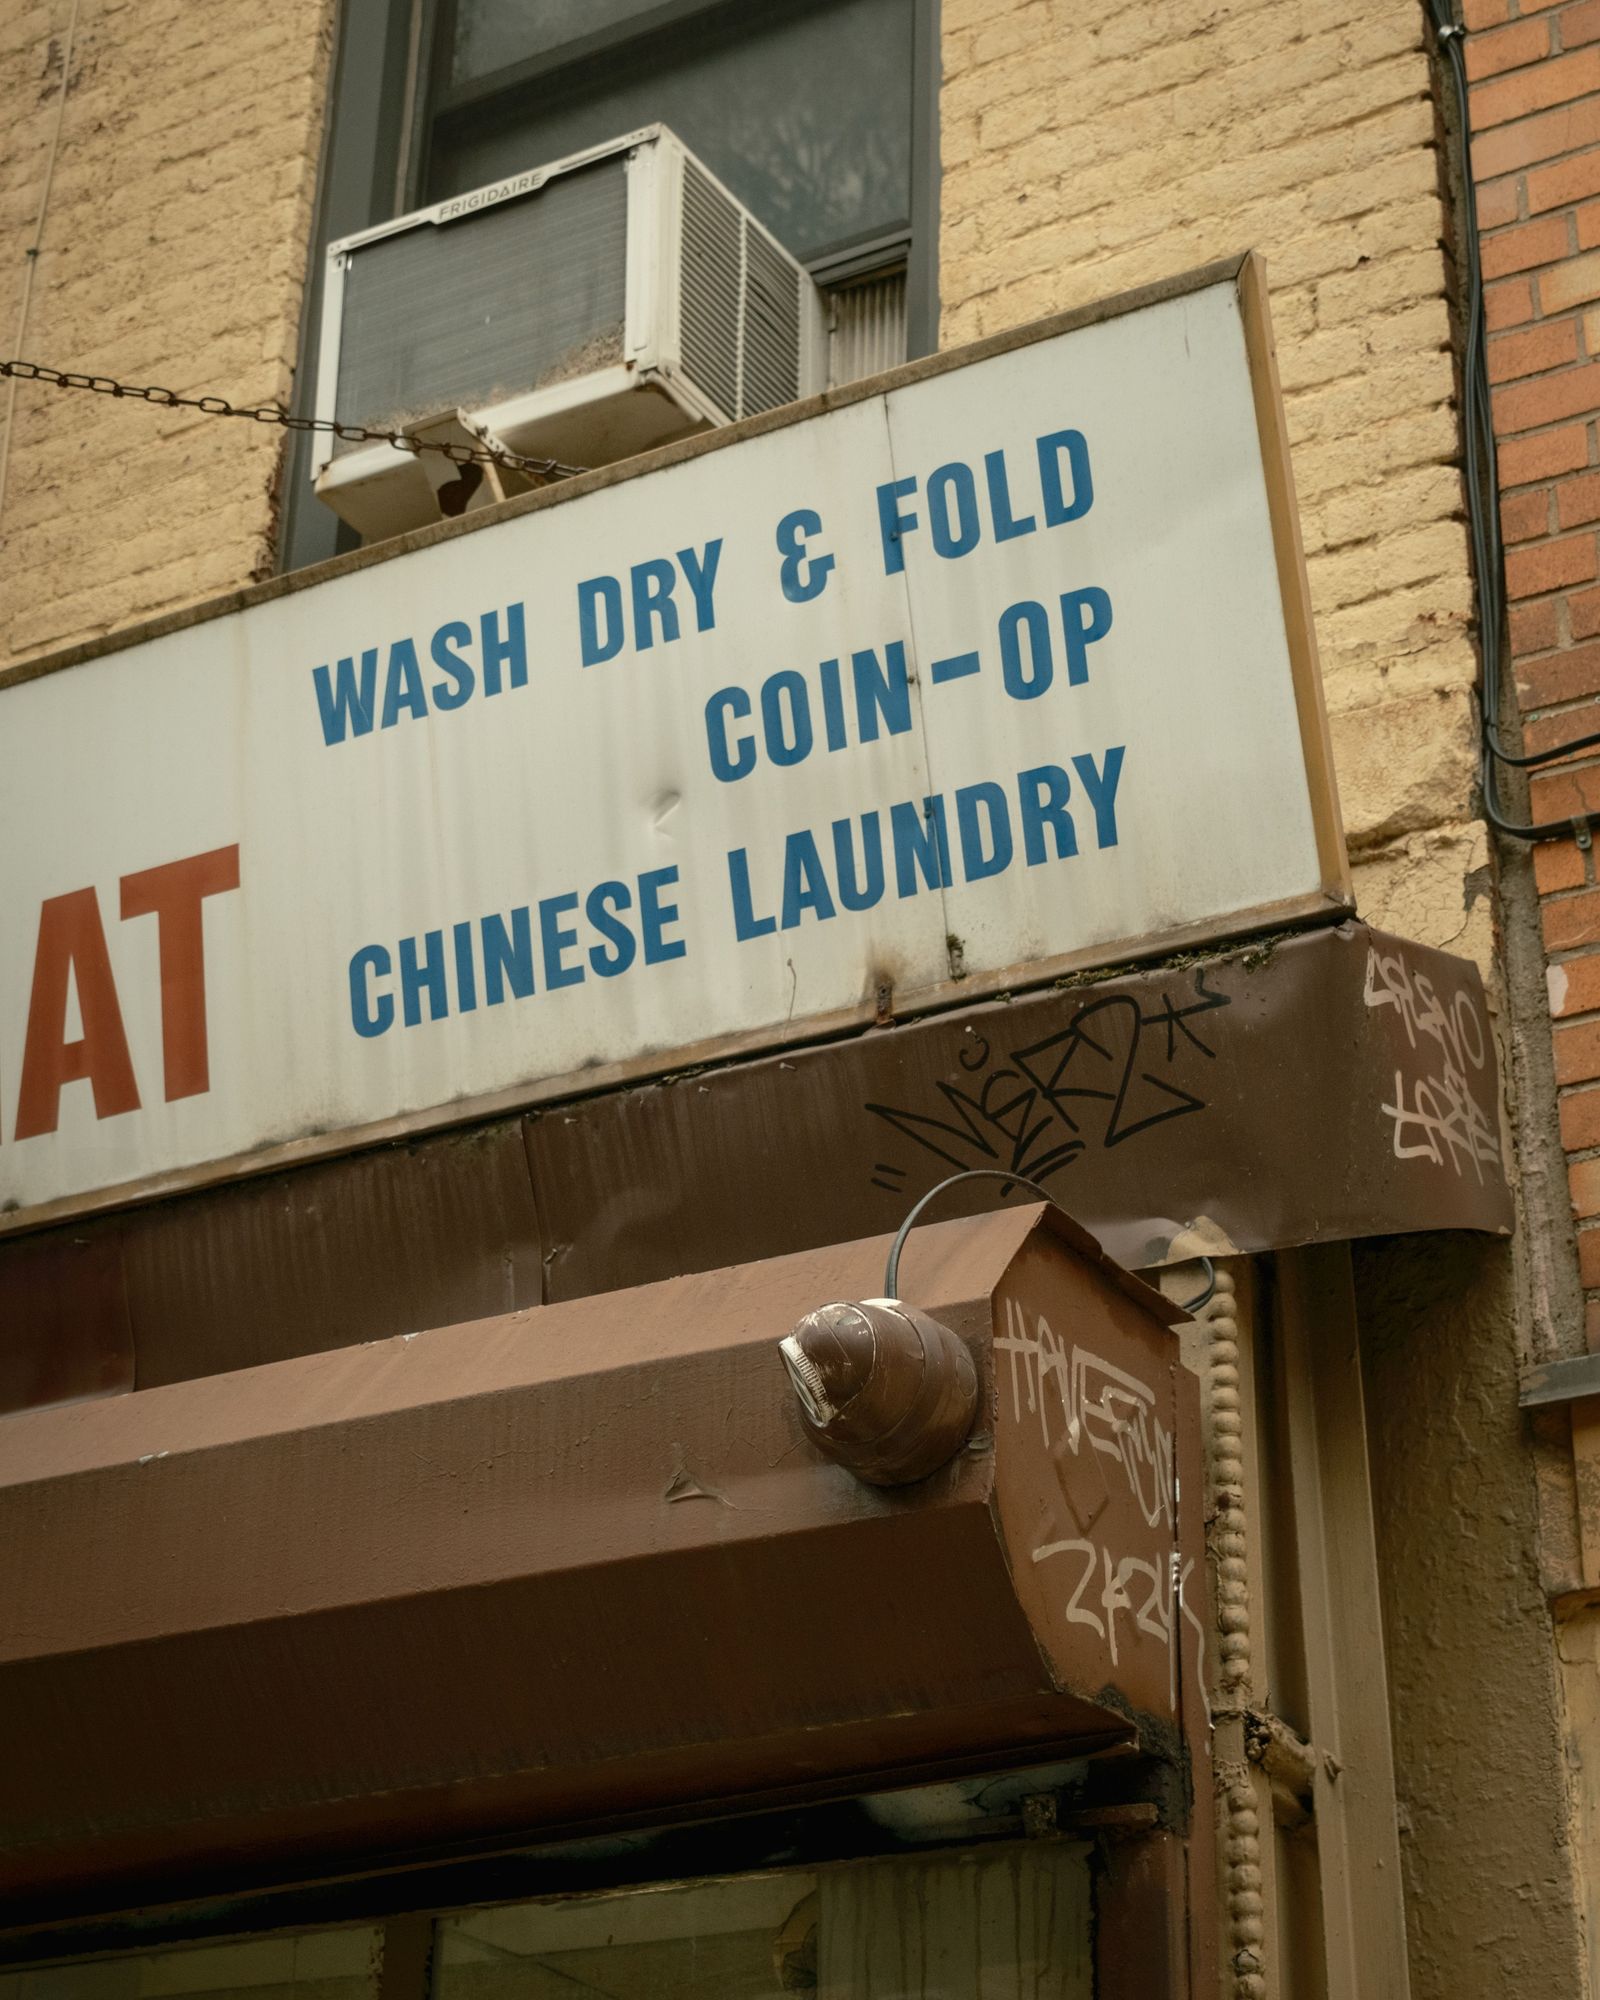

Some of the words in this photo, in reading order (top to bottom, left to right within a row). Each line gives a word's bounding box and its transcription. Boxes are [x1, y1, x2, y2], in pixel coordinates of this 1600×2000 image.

[439, 173, 543, 220] FRIGIDAIRE
[314, 602, 528, 745] WASH
[578, 539, 722, 667] DRY
[778, 509, 835, 603] &
[877, 429, 1093, 574] FOLD
[706, 587, 1112, 782] COIN-OP
[0, 844, 240, 1142] AT
[349, 866, 686, 1037] CHINESE
[729, 747, 1125, 941] LAUNDRY
